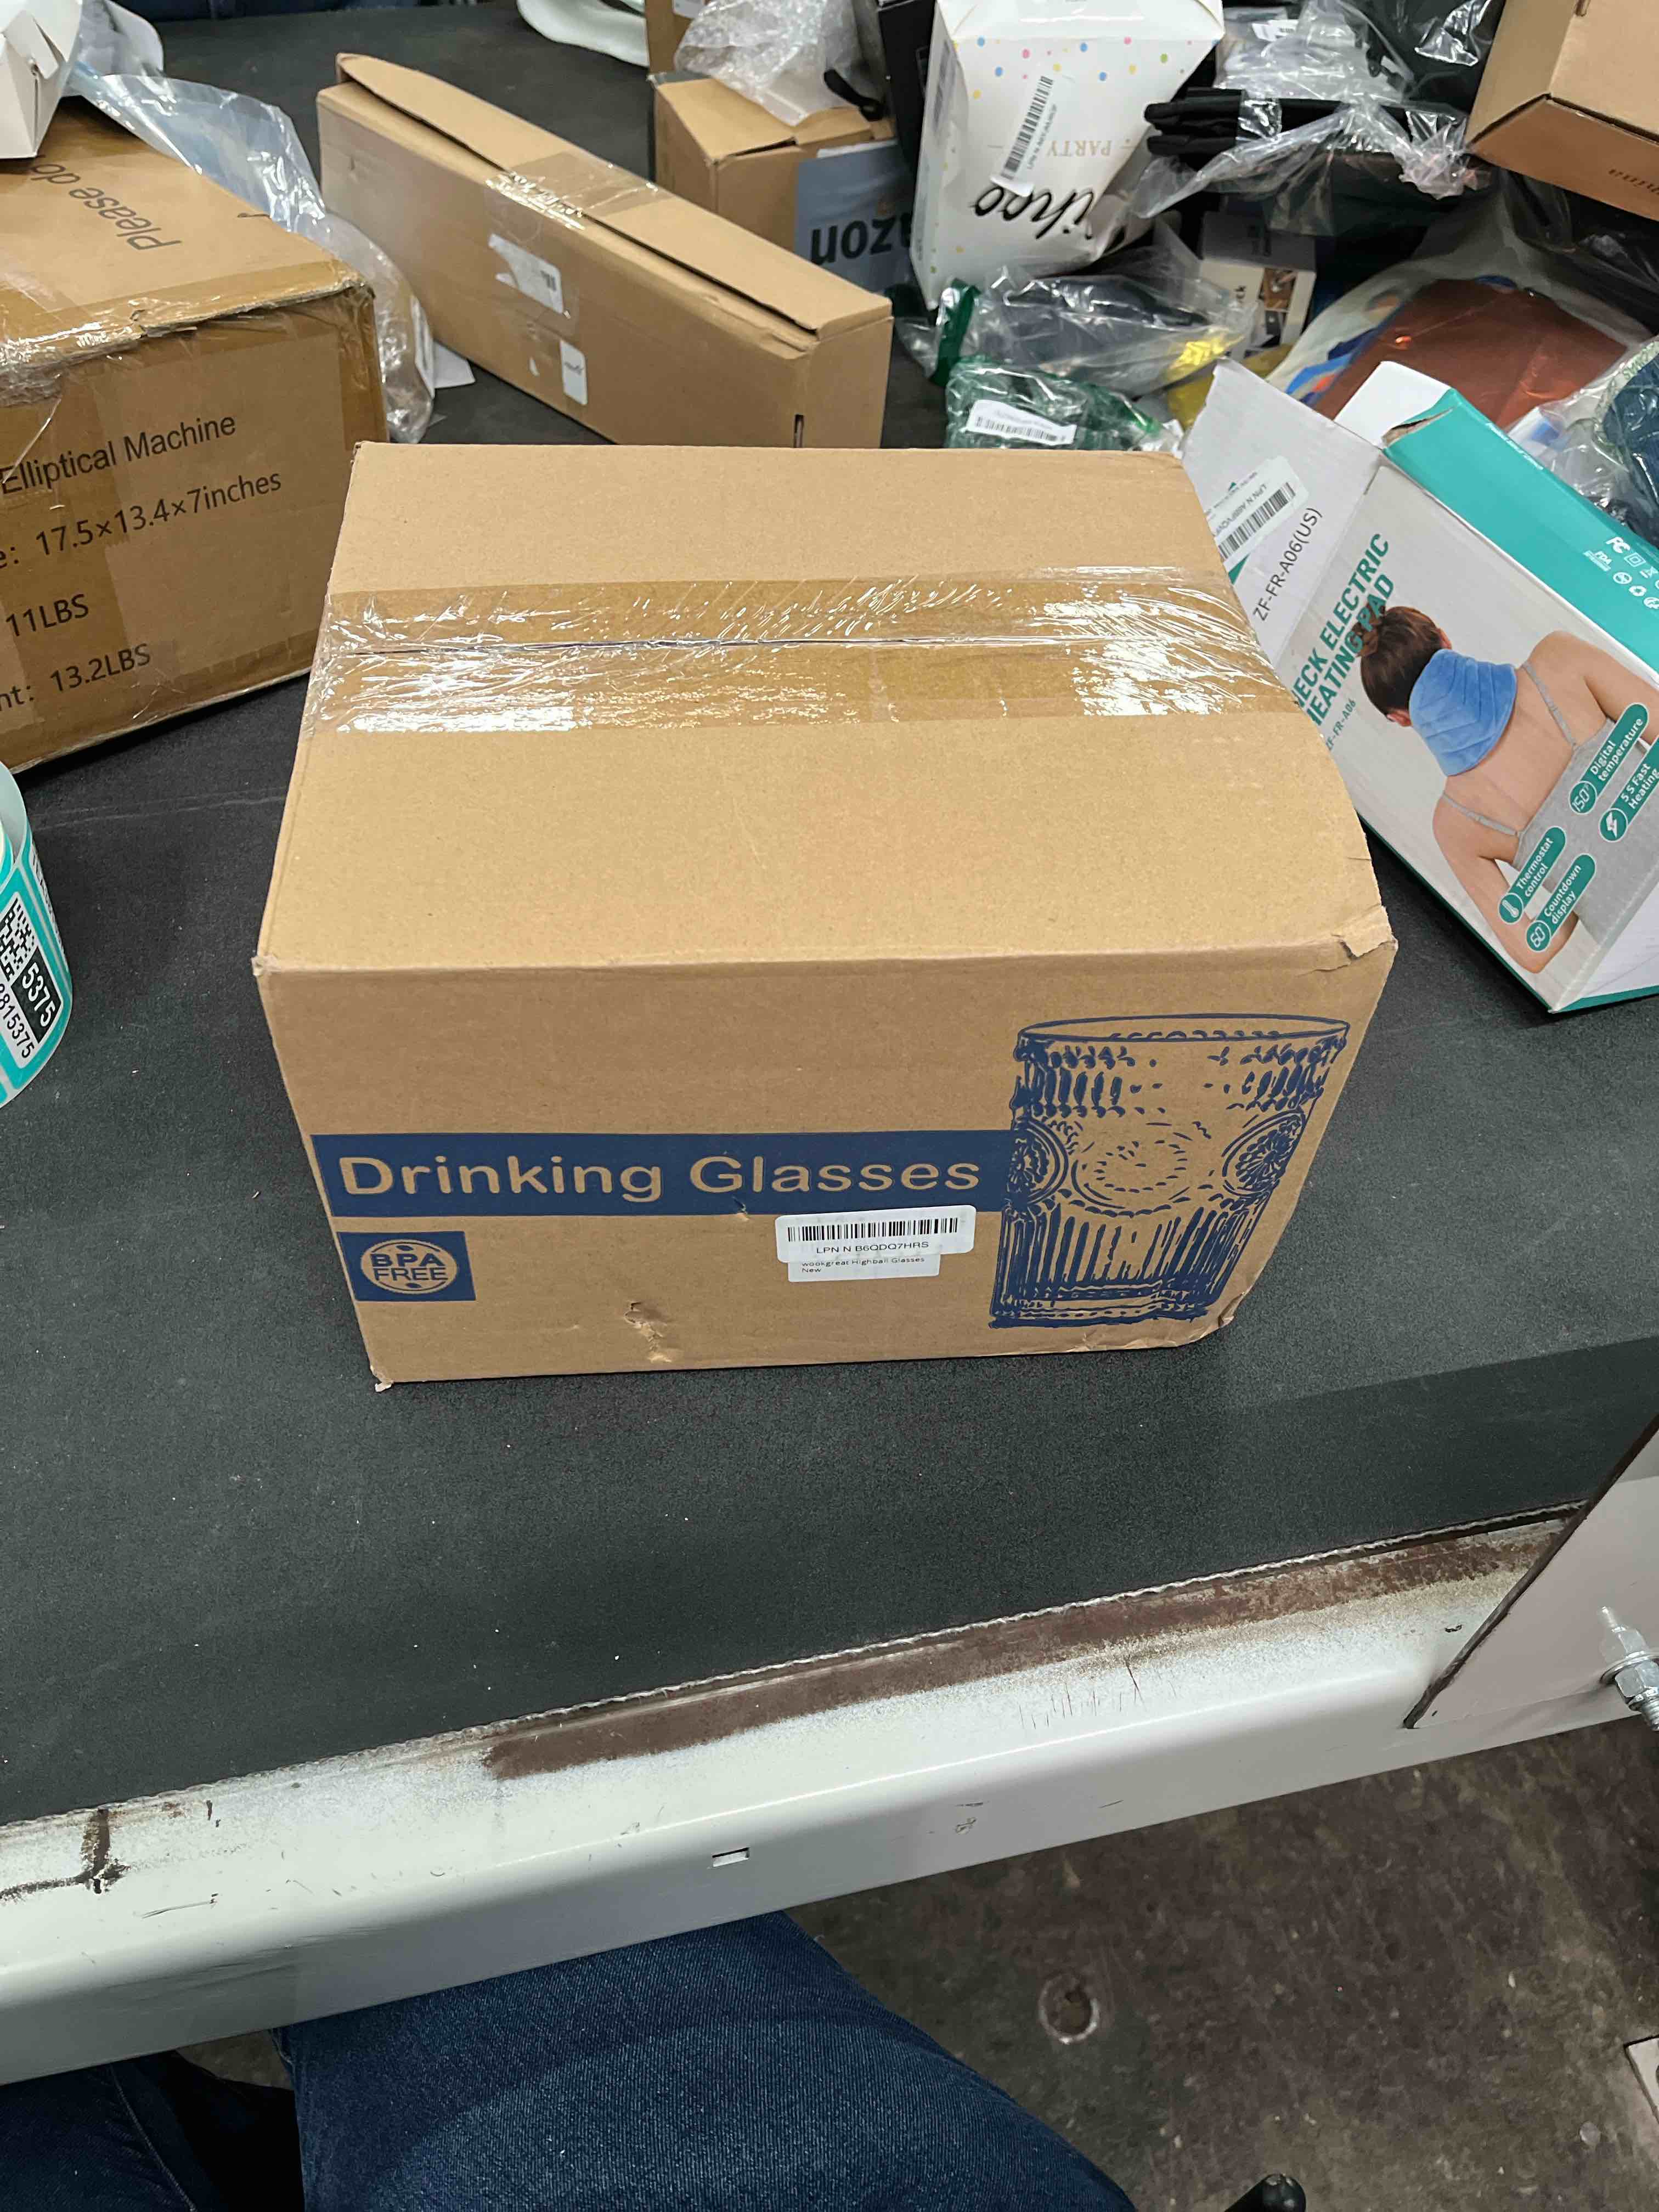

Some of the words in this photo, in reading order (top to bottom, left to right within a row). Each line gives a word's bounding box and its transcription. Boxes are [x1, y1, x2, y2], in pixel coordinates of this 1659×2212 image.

[1048, 139, 1112, 157] PARTY
[68, 187, 182, 250] Please
[0, 441, 117, 494] Elliptical
[123, 416, 236, 461] Machine
[1252, 507, 1323, 622] ZF-FR-A06(US)
[5, 593, 89, 637] 11LBS
[1319, 533, 1389, 651] ELECTRIC
[1356, 573, 1395, 633] PAD
[50, 643, 151, 692] 13.2LBS
[1590, 740, 1616, 775] Digital
[1598, 718, 1644, 782] temperature
[1632, 763, 1651, 785] Fast
[1628, 768, 1659, 810] Heating
[1515, 837, 1554, 890] Thermostat
[1524, 862, 1549, 898] control
[1543, 864, 1582, 917] Countdown
[1551, 890, 1576, 925] display
[22, 962, 55, 1027] 5375
[338, 1155, 663, 1203] Drinking
[689, 1155, 980, 1193] Glasses
[369, 1252, 446, 1267] BPA
[372, 1267, 448, 1281] FREE
